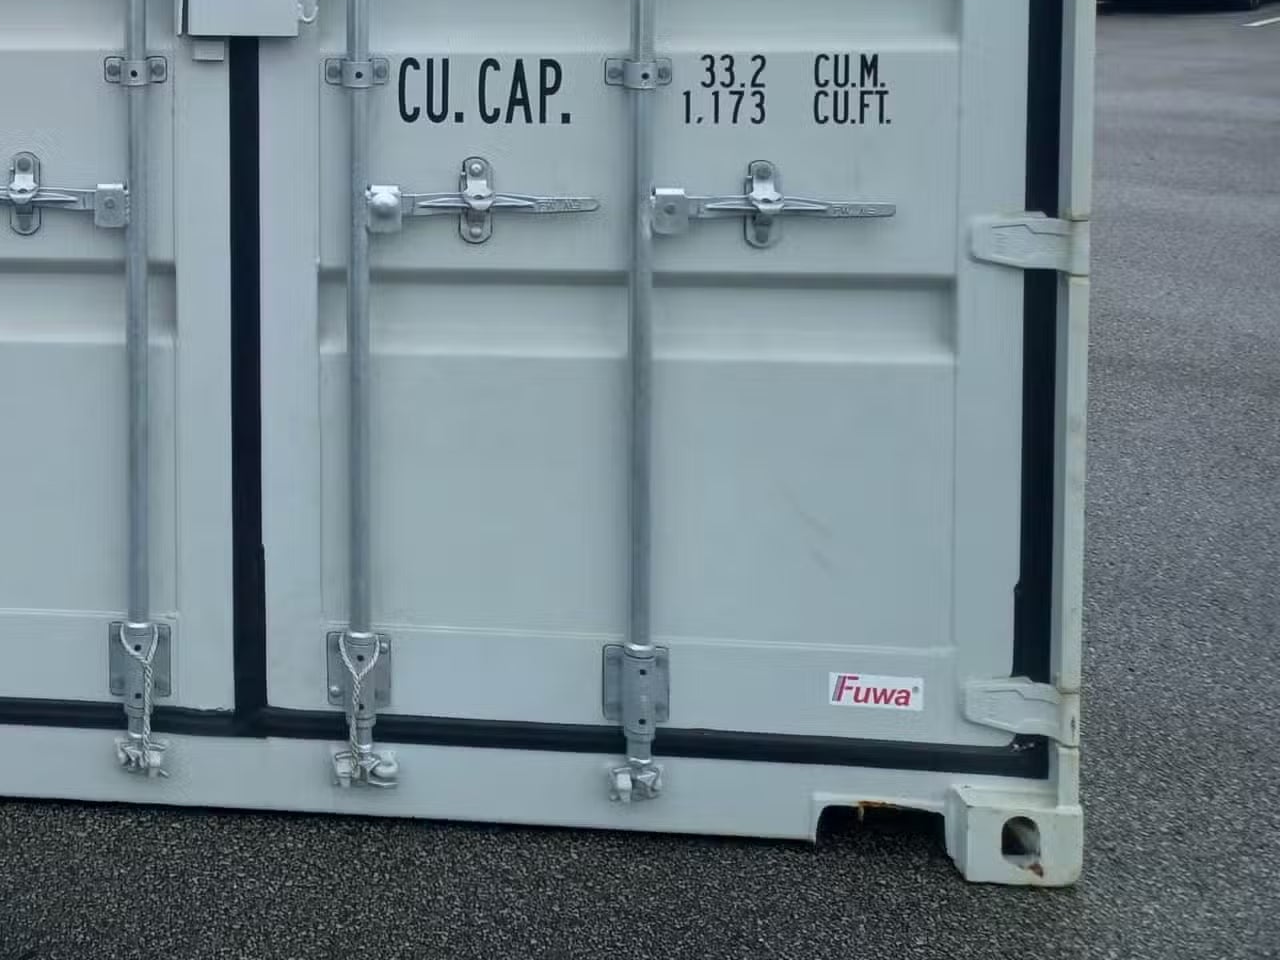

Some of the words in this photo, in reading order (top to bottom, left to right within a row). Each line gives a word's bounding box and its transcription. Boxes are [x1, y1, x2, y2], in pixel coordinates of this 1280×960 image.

[700, 54, 767, 89] 33.2
[814, 53, 887, 89] CU.M.
[682, 90, 766, 125] 1,173
[813, 90, 892, 125] CU.FT.
[832, 675, 911, 707] Fuwa
